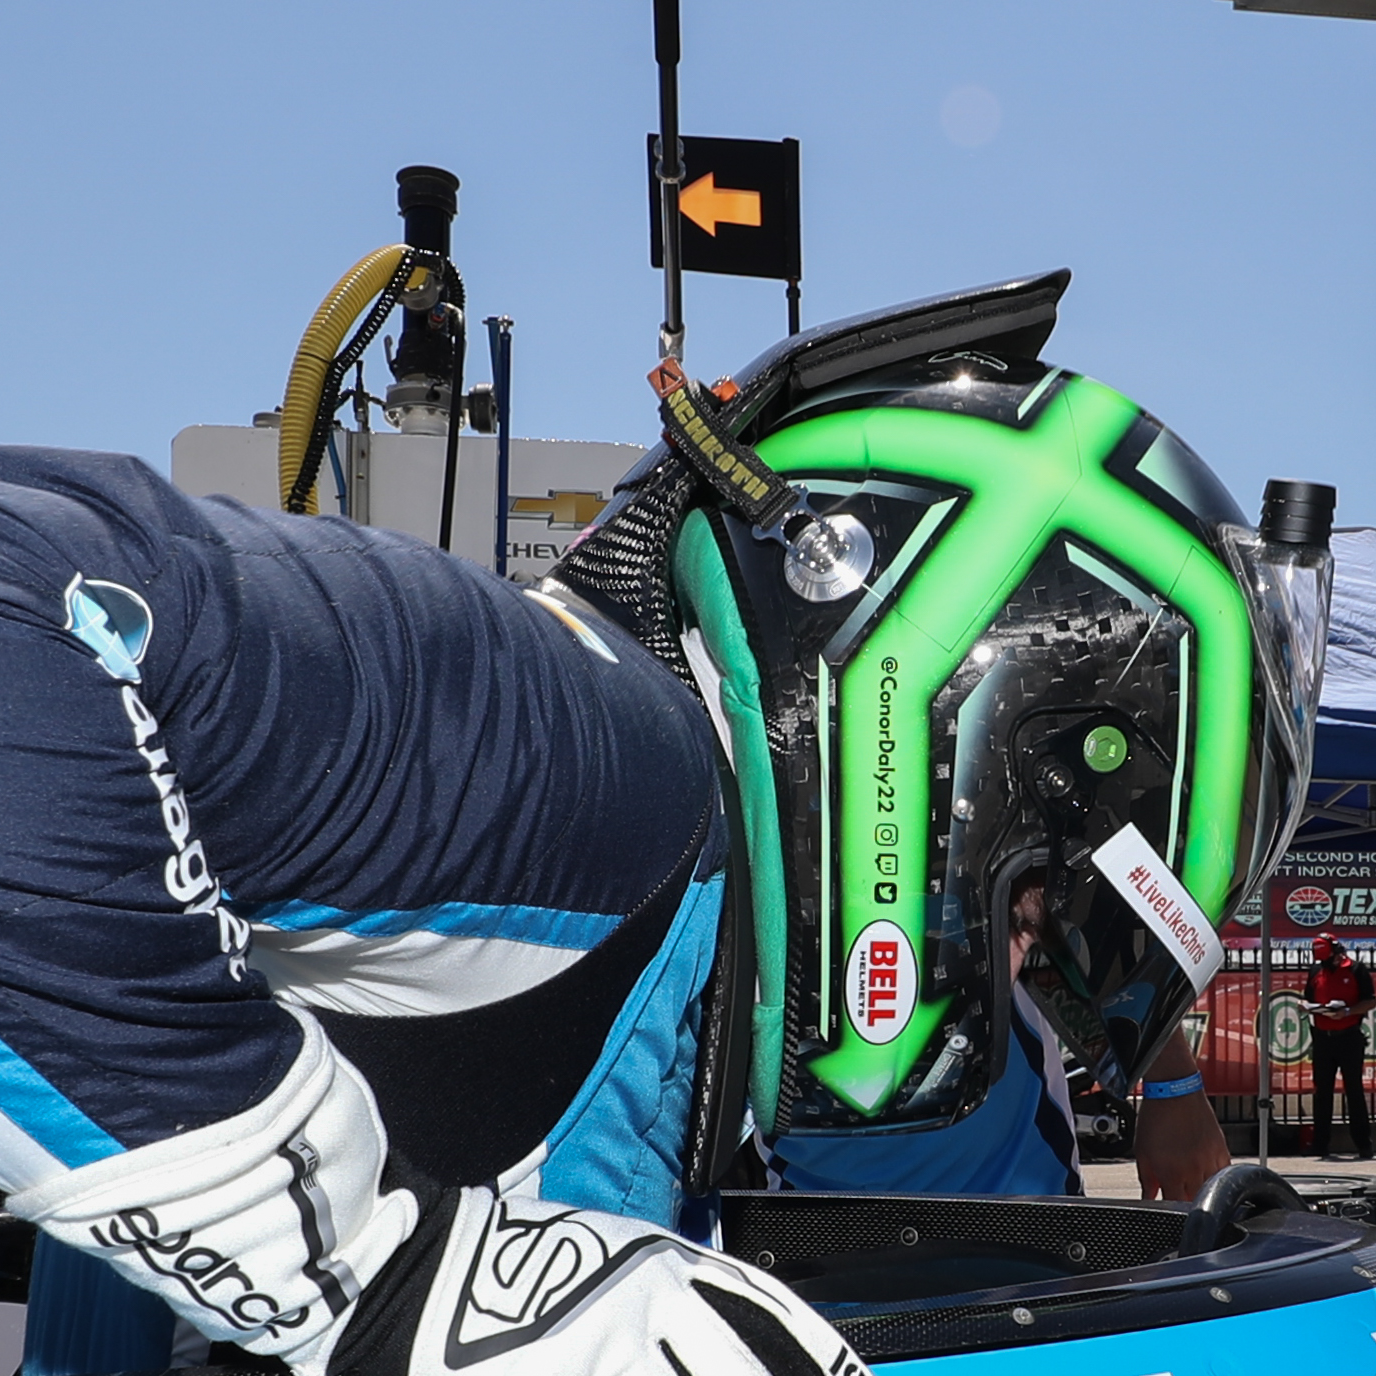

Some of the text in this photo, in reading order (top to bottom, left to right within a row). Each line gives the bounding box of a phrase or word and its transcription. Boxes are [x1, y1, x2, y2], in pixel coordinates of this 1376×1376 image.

[668, 388, 770, 501] SCHROTH
[873, 656, 899, 813] @ConorDaly22
[1285, 852, 1354, 862] SECOND
[1298, 866, 1371, 878] INDYCAR
[1127, 865, 1206, 965] #LiveLikeChris
[1333, 916, 1366, 926] MOTOR
[858, 951, 867, 1017] HELMETS
[867, 941, 898, 1027] BELL
